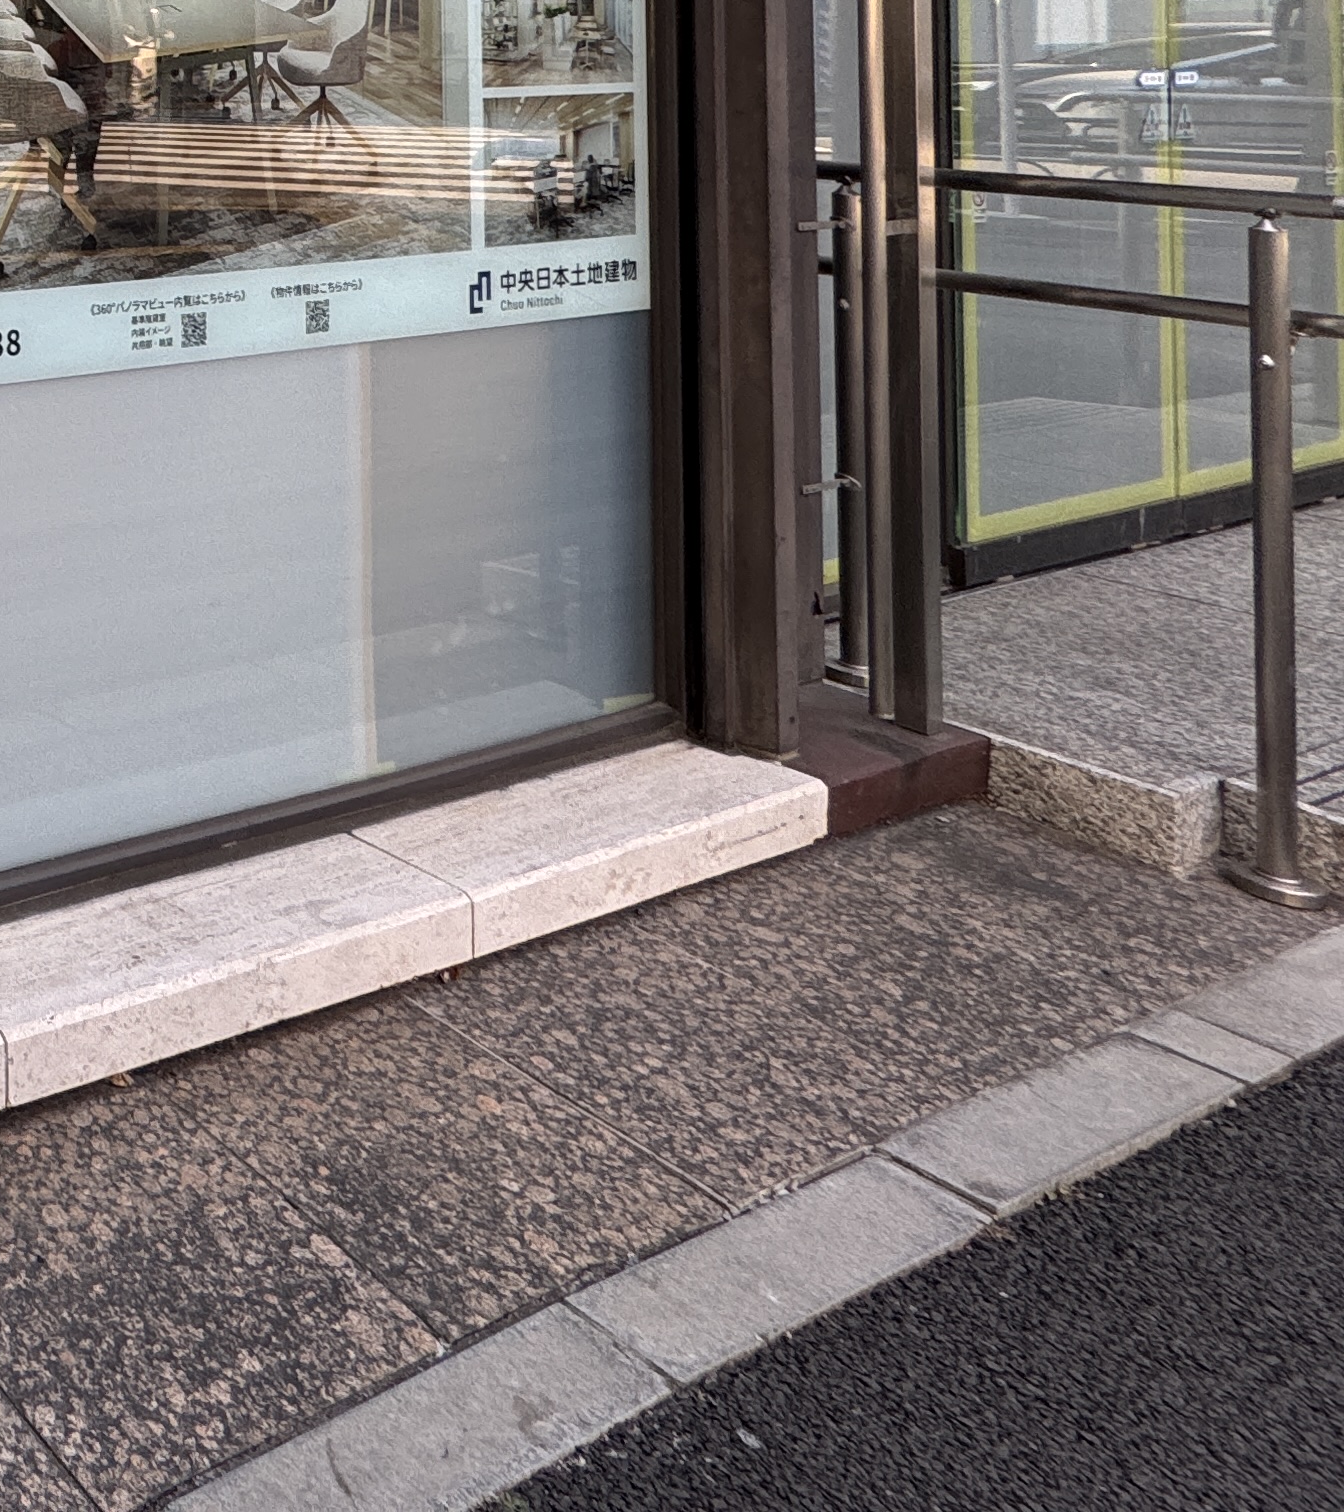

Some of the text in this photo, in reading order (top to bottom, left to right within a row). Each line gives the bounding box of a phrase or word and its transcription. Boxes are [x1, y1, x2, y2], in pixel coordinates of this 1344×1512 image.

[500, 258, 638, 294] 中央日本土地建物
